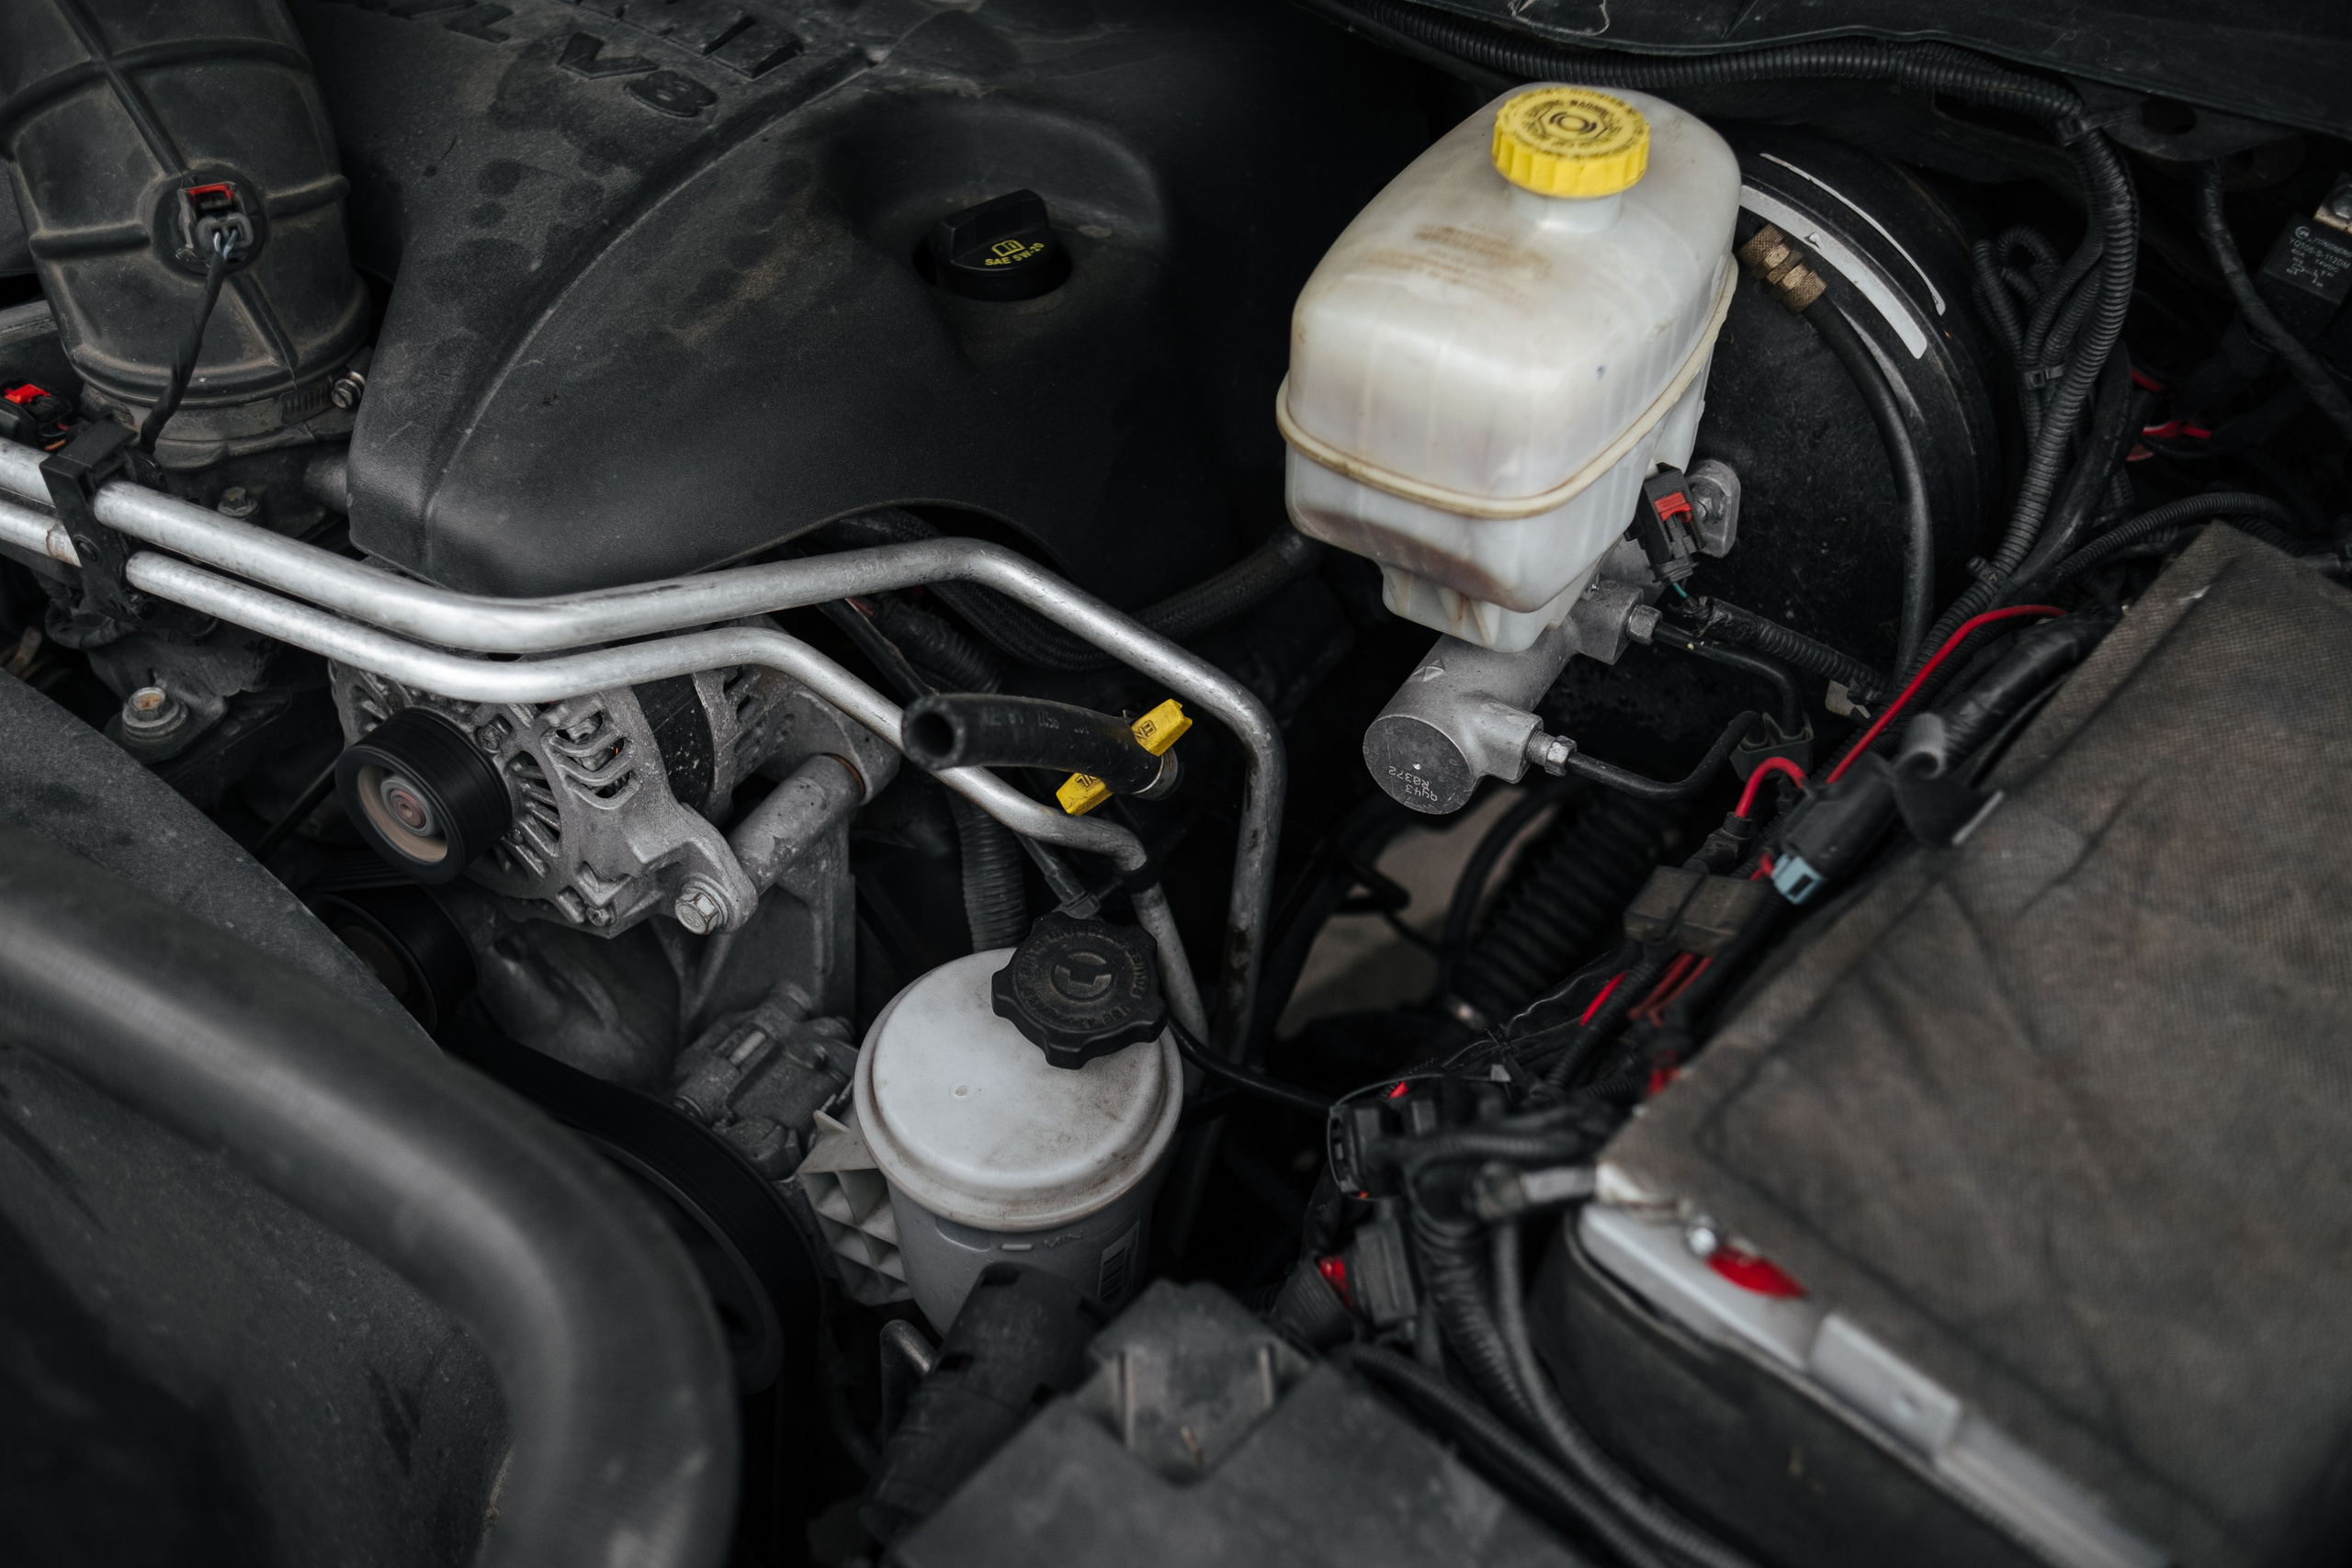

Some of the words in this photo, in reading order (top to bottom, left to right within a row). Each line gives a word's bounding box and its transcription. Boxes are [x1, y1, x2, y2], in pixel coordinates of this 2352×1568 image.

[557, 30, 718, 118] V8
[984, 255, 1012, 266] SAE
[1012, 243, 1046, 262] 5W-20
[1043, 1228, 1083, 1248] MIN
